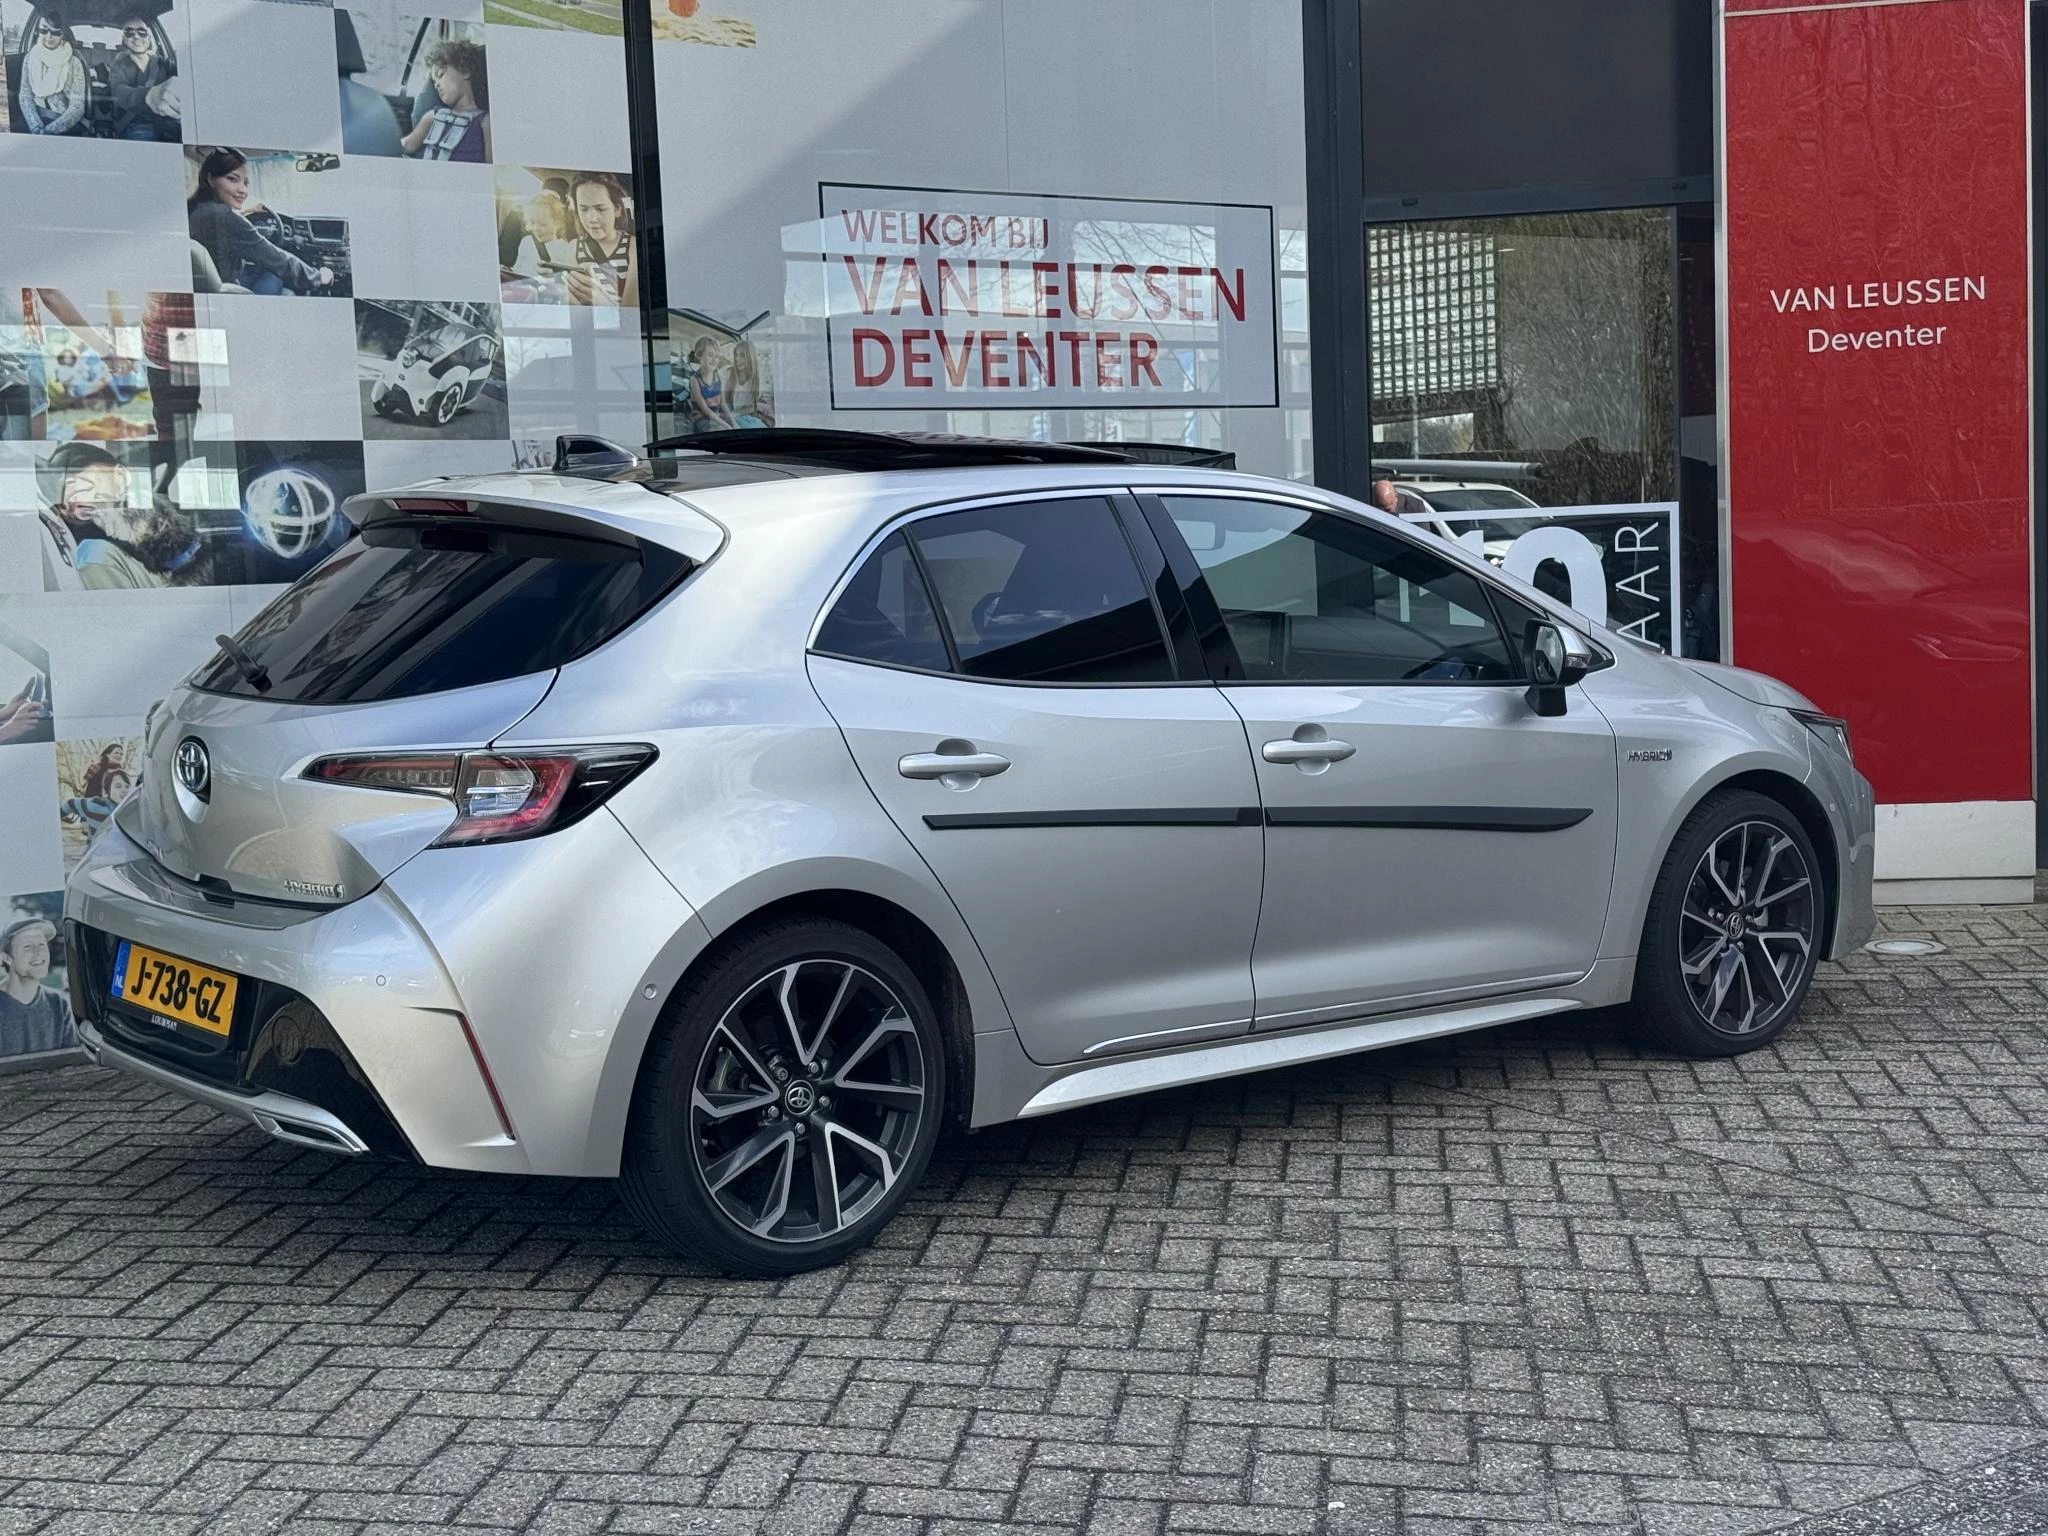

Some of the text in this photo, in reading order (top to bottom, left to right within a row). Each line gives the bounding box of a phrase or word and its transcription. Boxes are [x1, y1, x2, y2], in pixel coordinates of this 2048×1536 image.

[841, 209, 1049, 249] WELKOM BIJ
[843, 255, 1246, 322] VAN LEUSSEN
[1769, 275, 1985, 313] VAN LEUSSEN
[852, 328, 1163, 388] DEVENTER
[1808, 324, 1947, 353] Deventer
[114, 974, 124, 989] NL
[131, 956, 227, 1024] J-738-GZ
